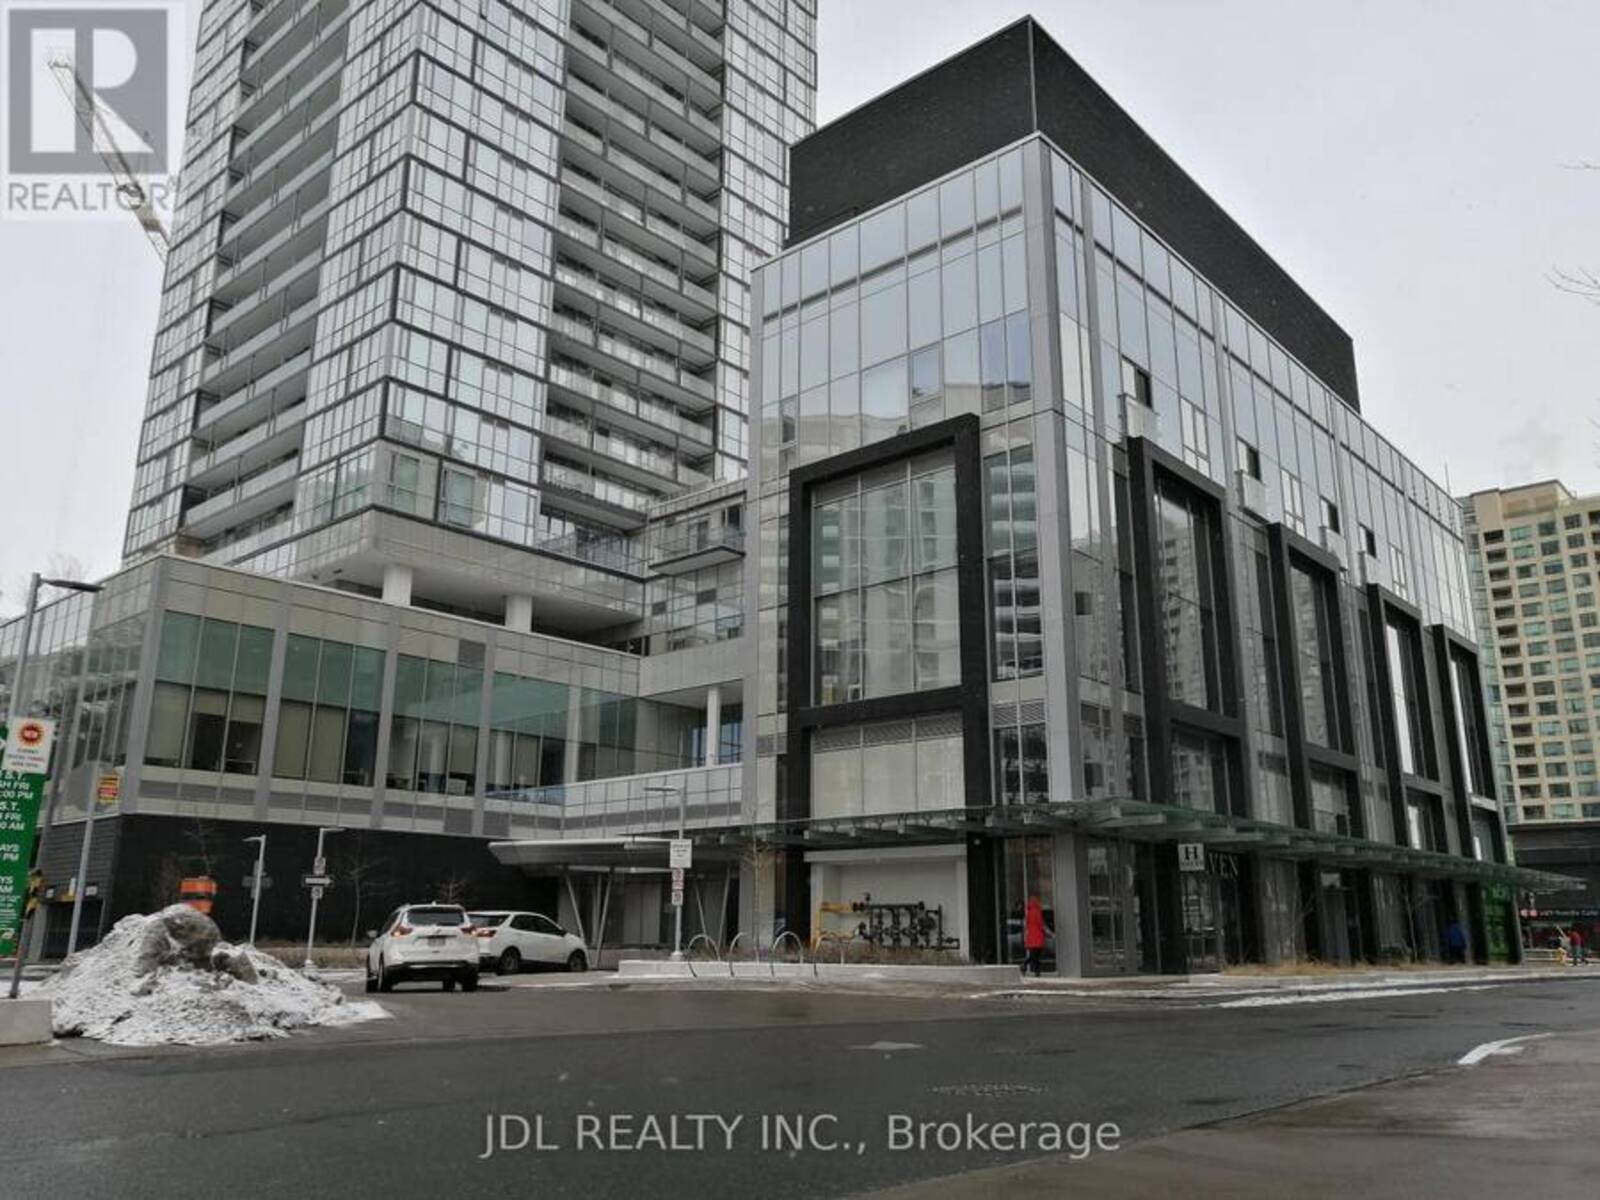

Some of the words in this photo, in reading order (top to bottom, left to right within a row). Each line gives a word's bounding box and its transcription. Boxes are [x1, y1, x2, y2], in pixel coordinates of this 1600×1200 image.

[17, 790, 34, 800] PM
[8, 822, 25, 830] AM
[0, 844, 19, 852] AYS
[1206, 852, 1238, 878] VEN
